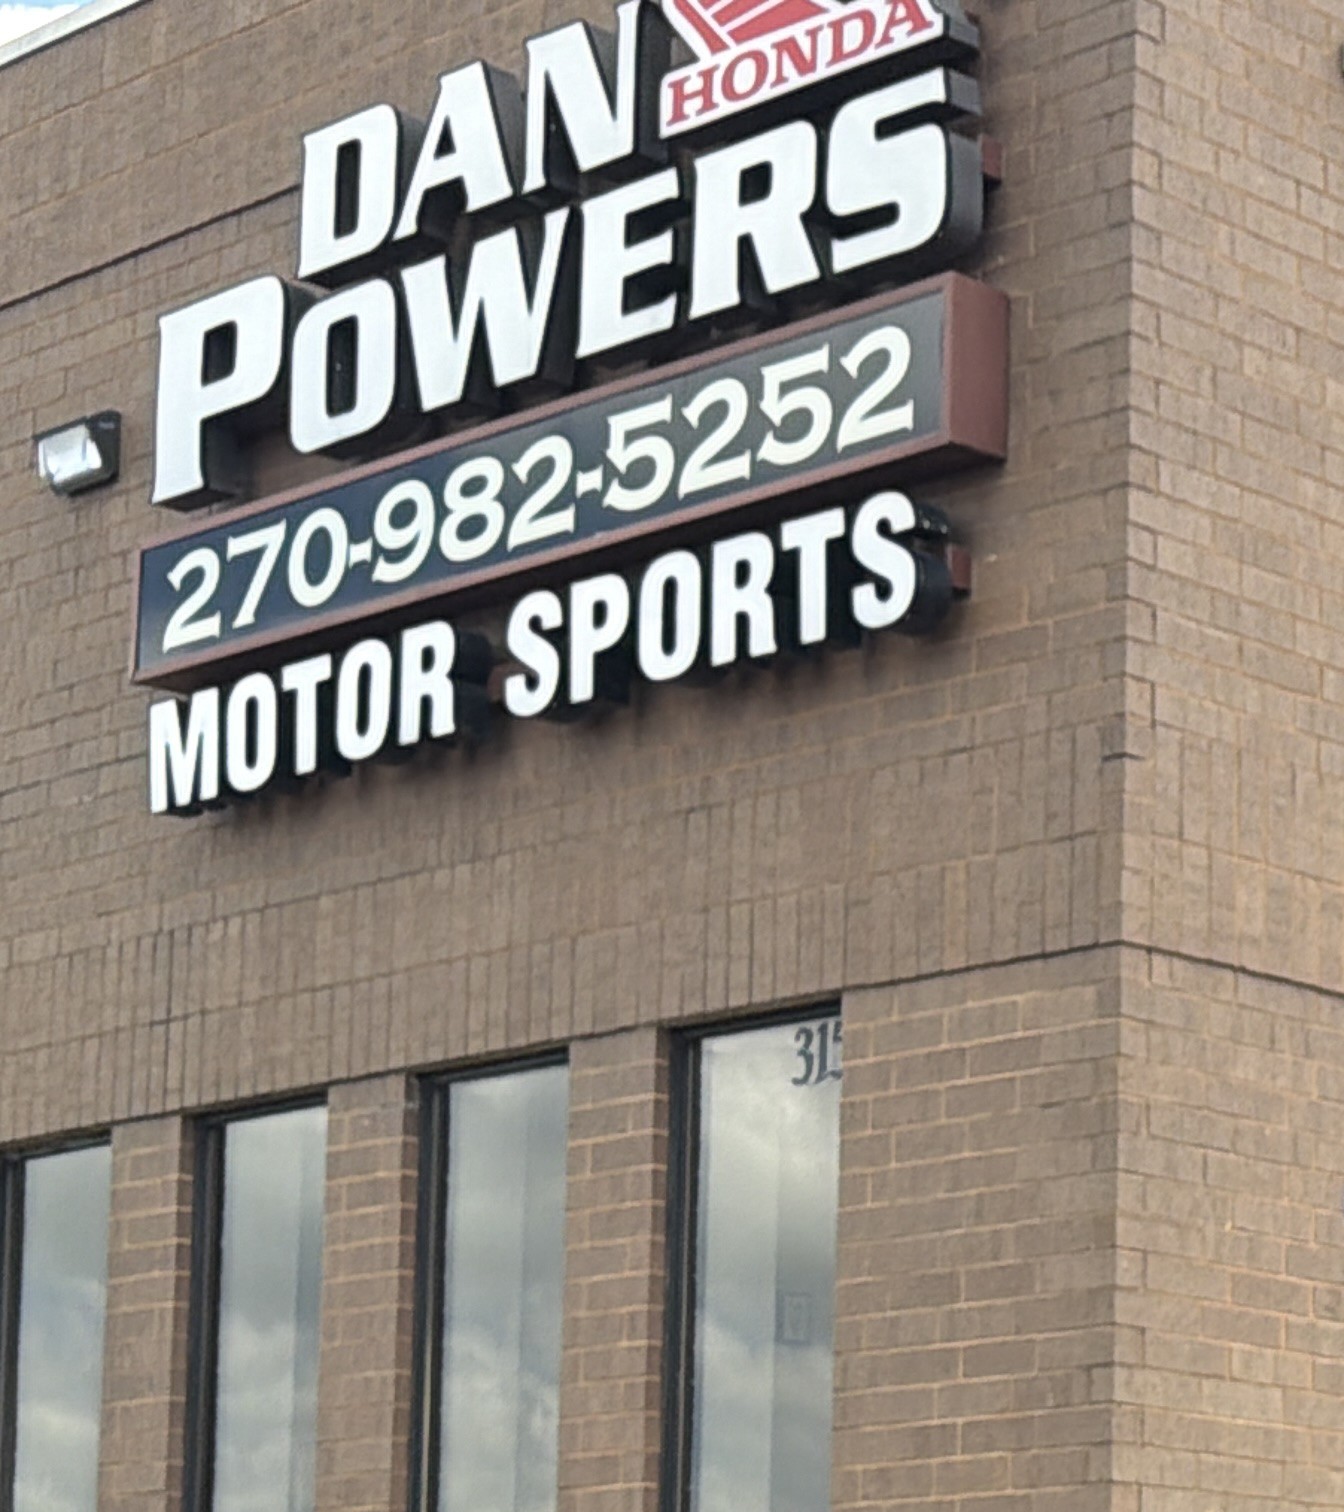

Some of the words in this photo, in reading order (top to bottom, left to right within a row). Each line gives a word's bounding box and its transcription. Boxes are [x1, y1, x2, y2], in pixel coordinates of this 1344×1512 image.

[298, 0, 640, 279] DAN
[667, 0, 934, 126] HONDA
[151, 66, 947, 507] POWERS
[149, 621, 457, 815] MOTOR
[504, 490, 918, 718] SPORTS
[162, 326, 914, 654] 270-982-5252
